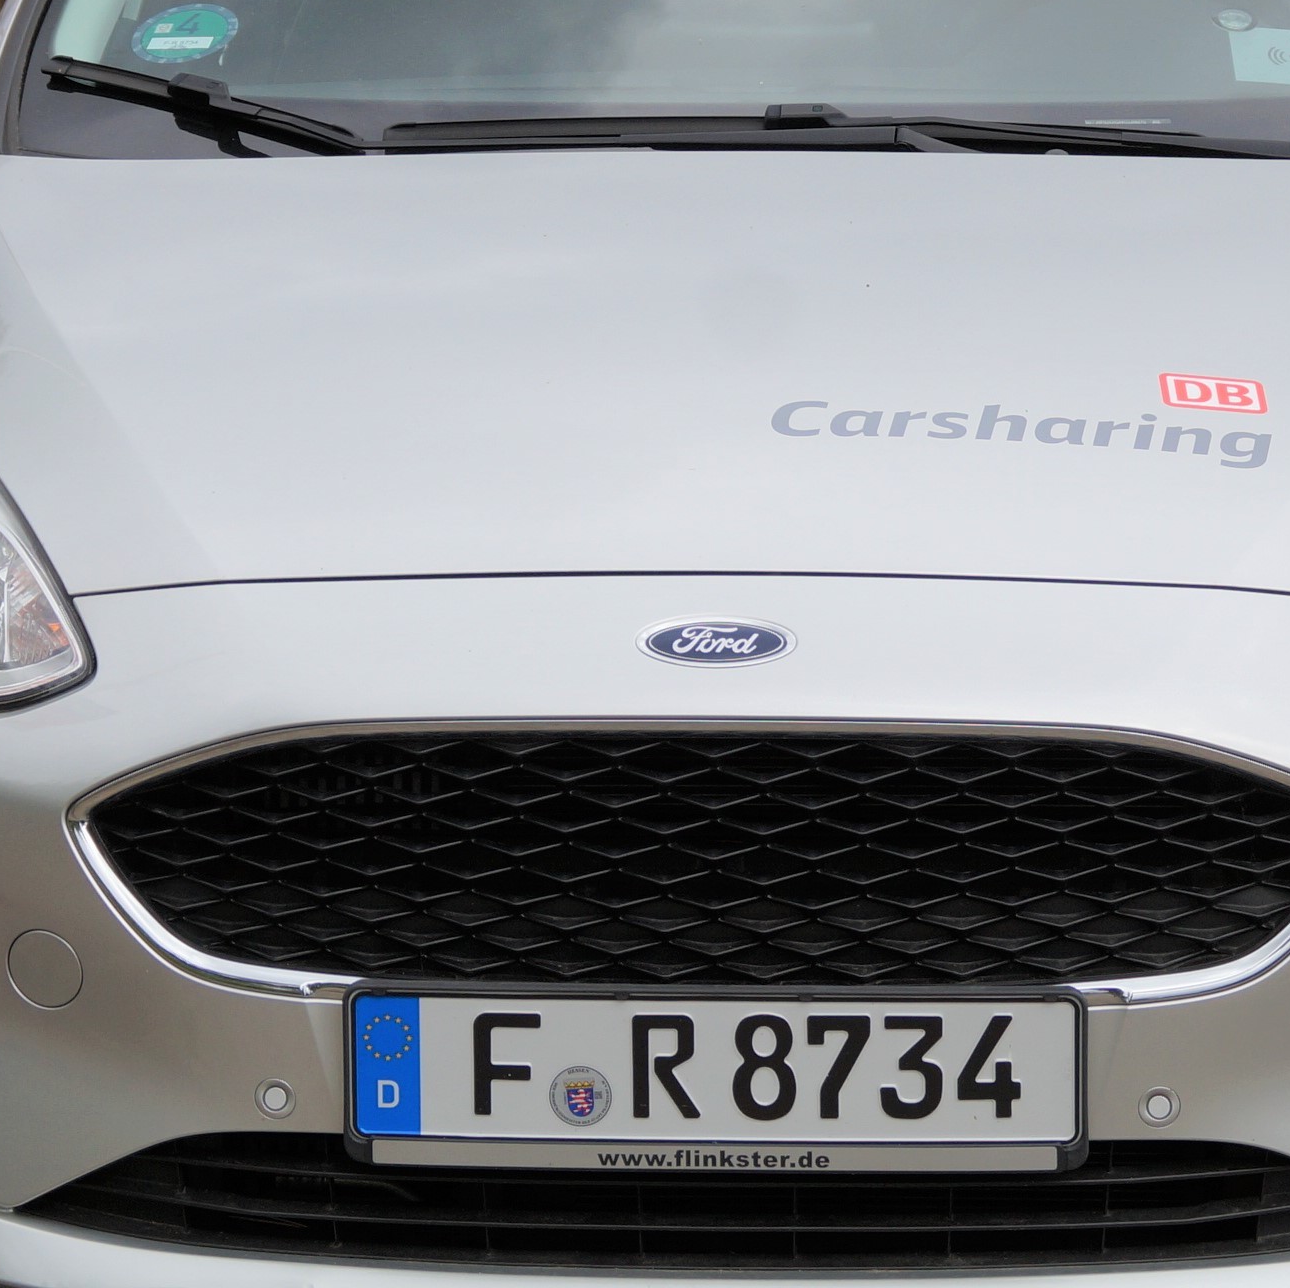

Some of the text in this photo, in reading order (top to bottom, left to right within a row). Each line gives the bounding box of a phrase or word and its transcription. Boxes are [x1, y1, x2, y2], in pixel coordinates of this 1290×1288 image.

[175, 12, 202, 34] 4
[1174, 378, 1254, 407] DB
[770, 400, 1272, 469] Carsharing
[672, 626, 759, 654] Ford
[473, 1013, 541, 1115] F
[632, 1014, 701, 1118] R
[732, 1014, 1022, 1119] 8734
[377, 1079, 400, 1108] D
[598, 1149, 830, 1169] www.flinkster.de
